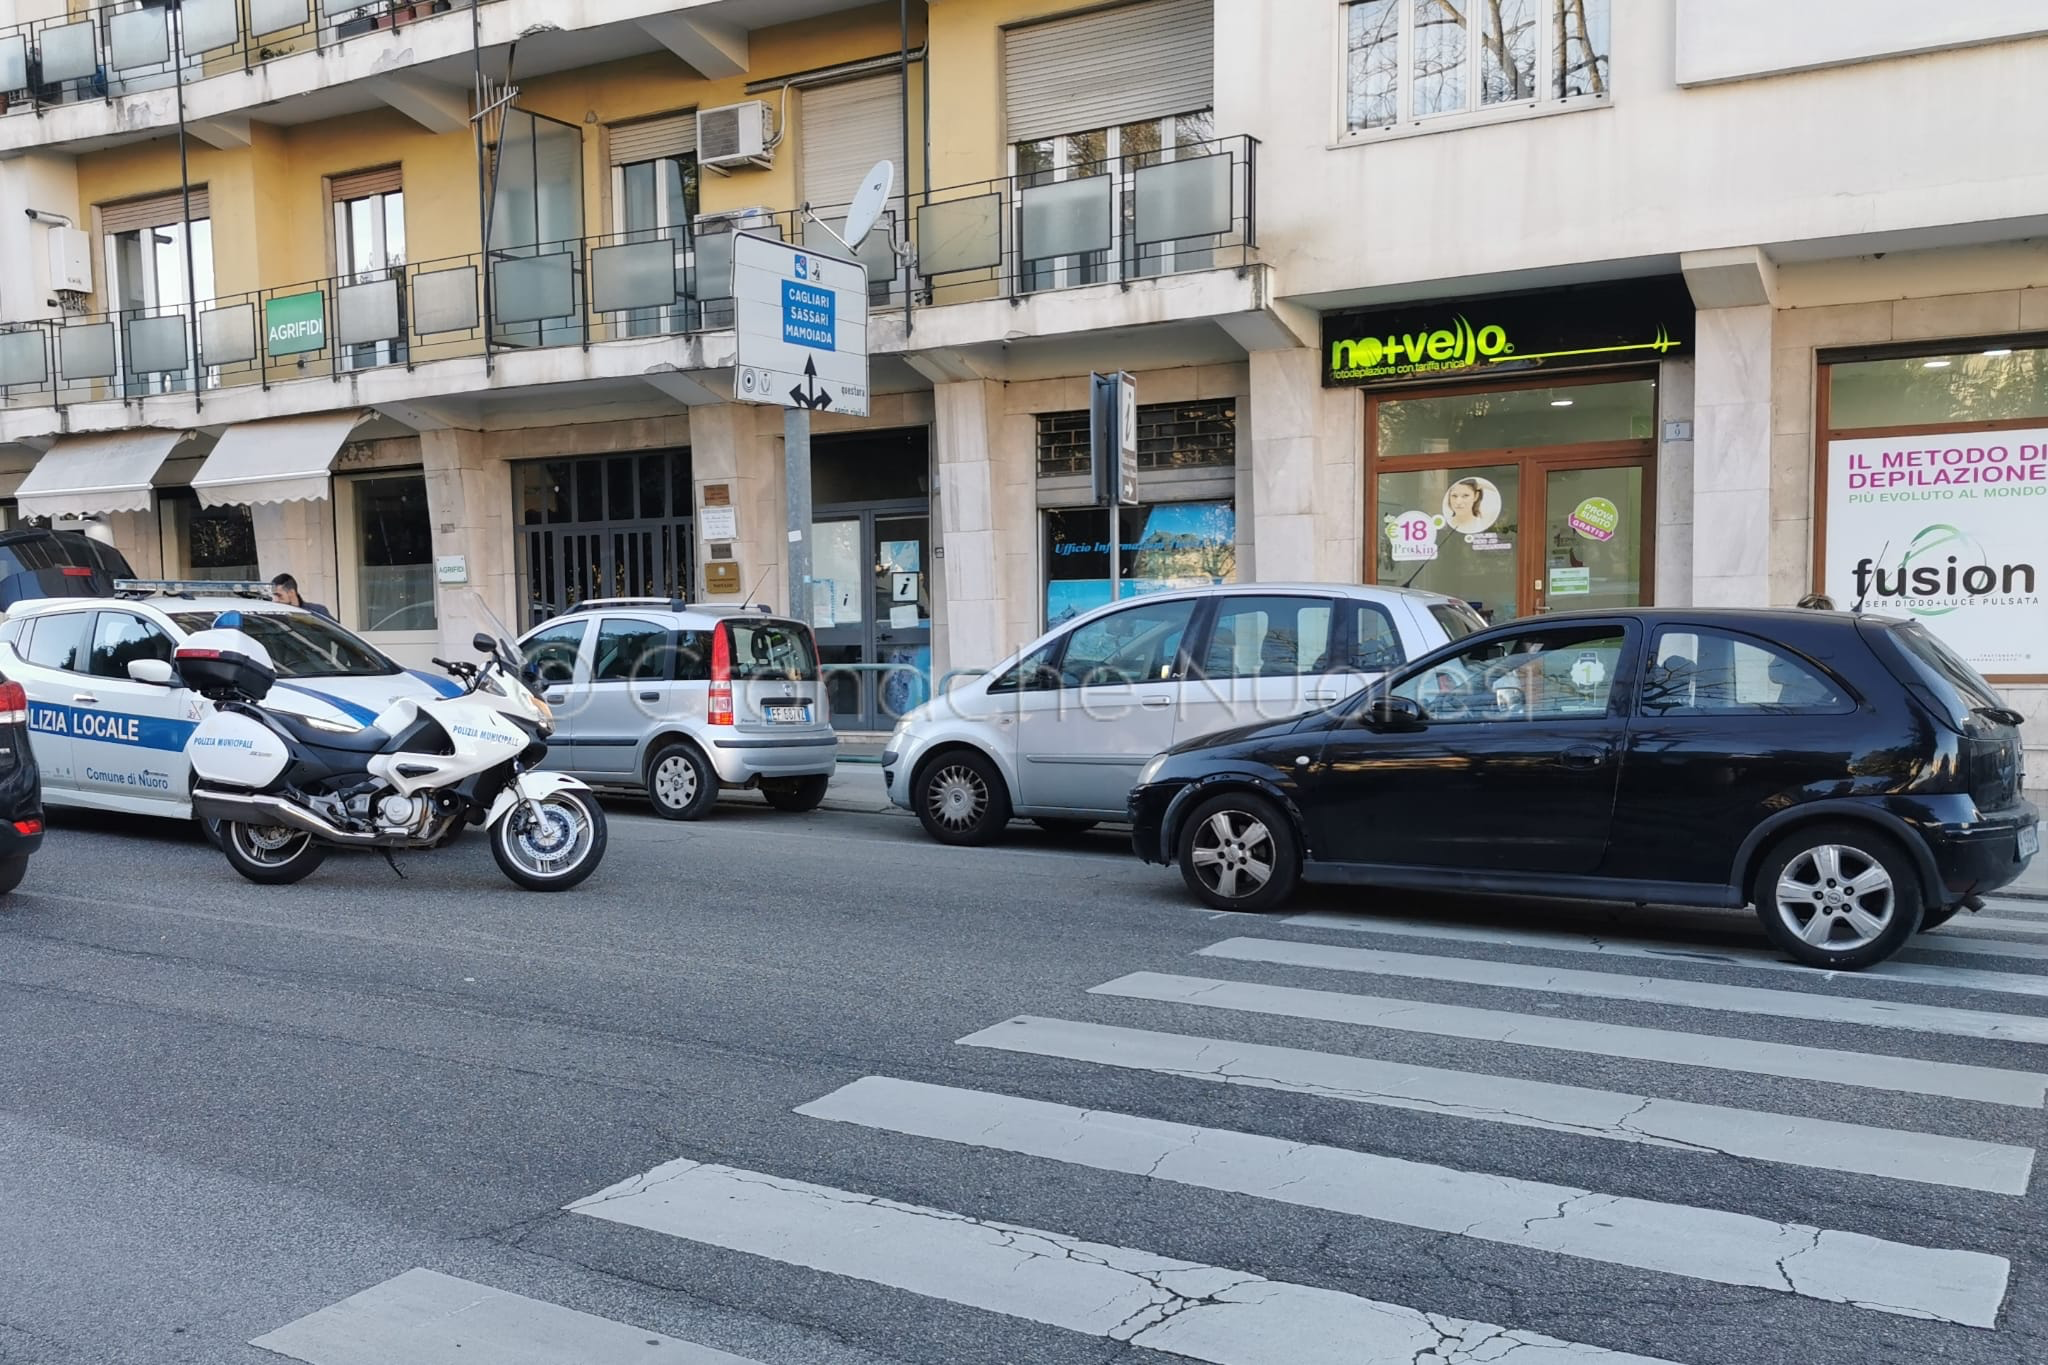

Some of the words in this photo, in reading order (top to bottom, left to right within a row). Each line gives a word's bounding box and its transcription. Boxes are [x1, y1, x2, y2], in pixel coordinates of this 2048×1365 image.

[789, 288, 830, 308] CAGLIARI
[790, 306, 829, 326] SASSARI
[269, 317, 323, 341] AGRIFIDI
[785, 324, 833, 344] MAMOIADA
[1397, 365, 1414, 374] con
[1415, 360, 1440, 373] tariffa
[1441, 359, 1466, 370] unica
[1848, 453, 1872, 470] IL
[1882, 446, 2009, 468] METODO
[2019, 443, 2048, 462] DI
[1848, 464, 2047, 489] DEPILAZIONE
[1848, 490, 1874, 504] PIÙ
[1879, 489, 1954, 502] EVOLUTO
[1958, 488, 1978, 499] AL
[1984, 486, 2048, 498] MONDO
[1581, 510, 1611, 528] SUBITO
[1584, 503, 1614, 522] PROVA
[1572, 519, 1605, 538] GRATIS
[1054, 543, 1092, 556] Ufficio
[438, 564, 465, 575] AGRIFIDI
[1851, 555, 2035, 598] fusion
[1850, 600, 1889, 608] LSER
[1895, 598, 1976, 607] DIODO+LUCE
[1983, 596, 2039, 606] PULSATA
[28, 708, 67, 733] LIZIA
[73, 712, 139, 741] LOCALE
[193, 737, 216, 746] POLIZIA
[217, 738, 254, 749] MUNICIPALE
[452, 725, 478, 737] POLIZIA
[479, 730, 519, 747] MUNICIPALE
[86, 767, 125, 784] Comune
[127, 770, 136, 785] di
[138, 772, 168, 790] Nuoro
